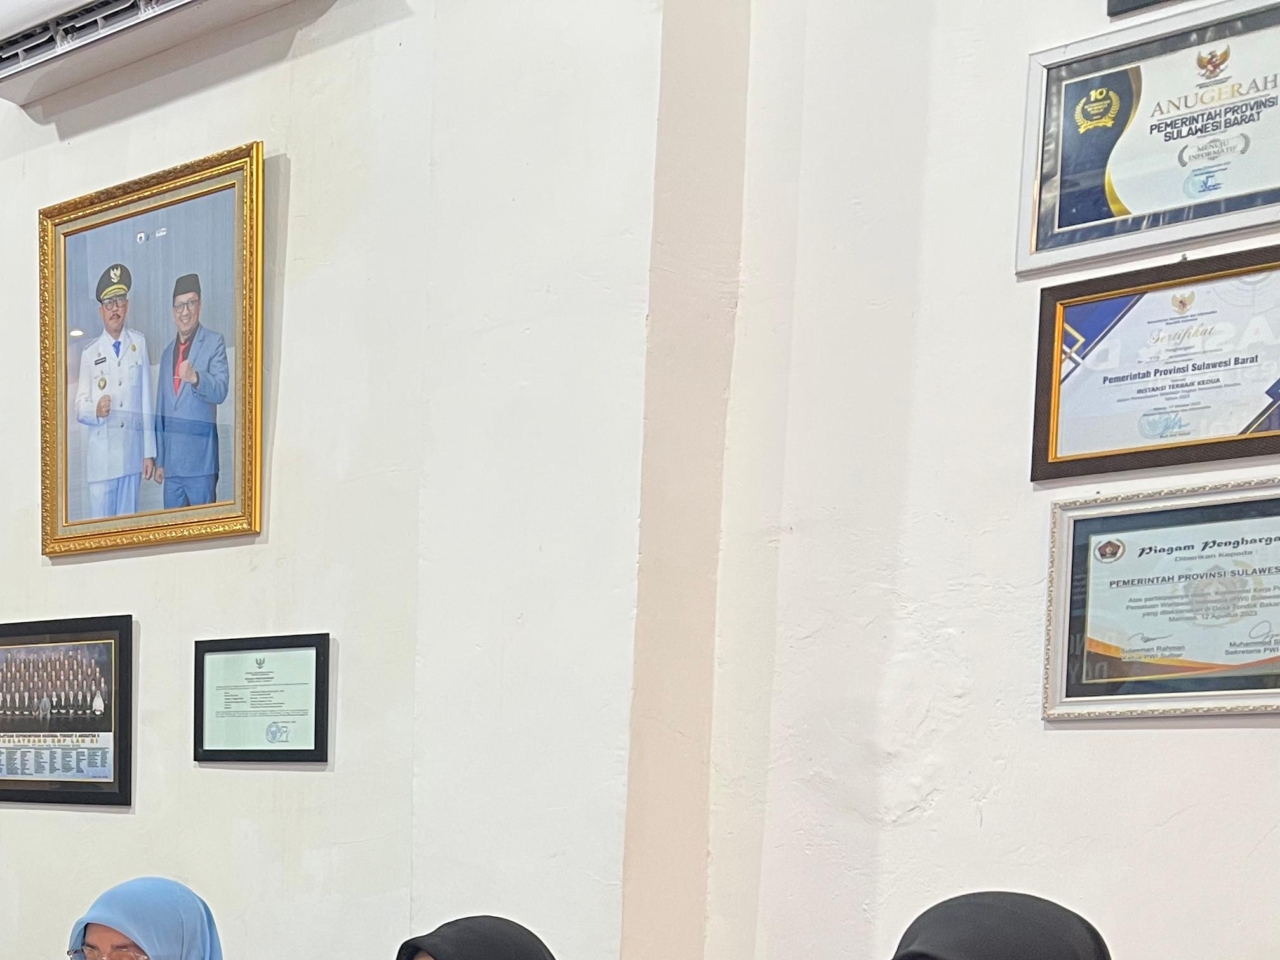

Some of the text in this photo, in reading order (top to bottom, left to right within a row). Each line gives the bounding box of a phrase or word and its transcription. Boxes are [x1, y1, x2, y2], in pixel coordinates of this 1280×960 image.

[1150, 73, 1279, 118] ANUGERAH
[1150, 109, 1222, 135] PEMERINTAH
[1224, 95, 1279, 118] PROVINSI
[1164, 120, 1222, 142] SULAWESI
[1224, 110, 1263, 129] BARAT
[1148, 322, 1217, 345] Sertifikat
[1103, 370, 1151, 385] Pemerintah
[1154, 364, 1189, 378] Provinsi
[1191, 357, 1231, 372] Sulawesi
[1234, 354, 1259, 366] Barat
[1137, 544, 1195, 559] Piagam
[1174, 552, 1217, 563] Diberikan
[1218, 549, 1253, 558] Kepada
[1109, 575, 1175, 588] PEMERINTAH
[1178, 571, 1227, 582] PROVINSI
